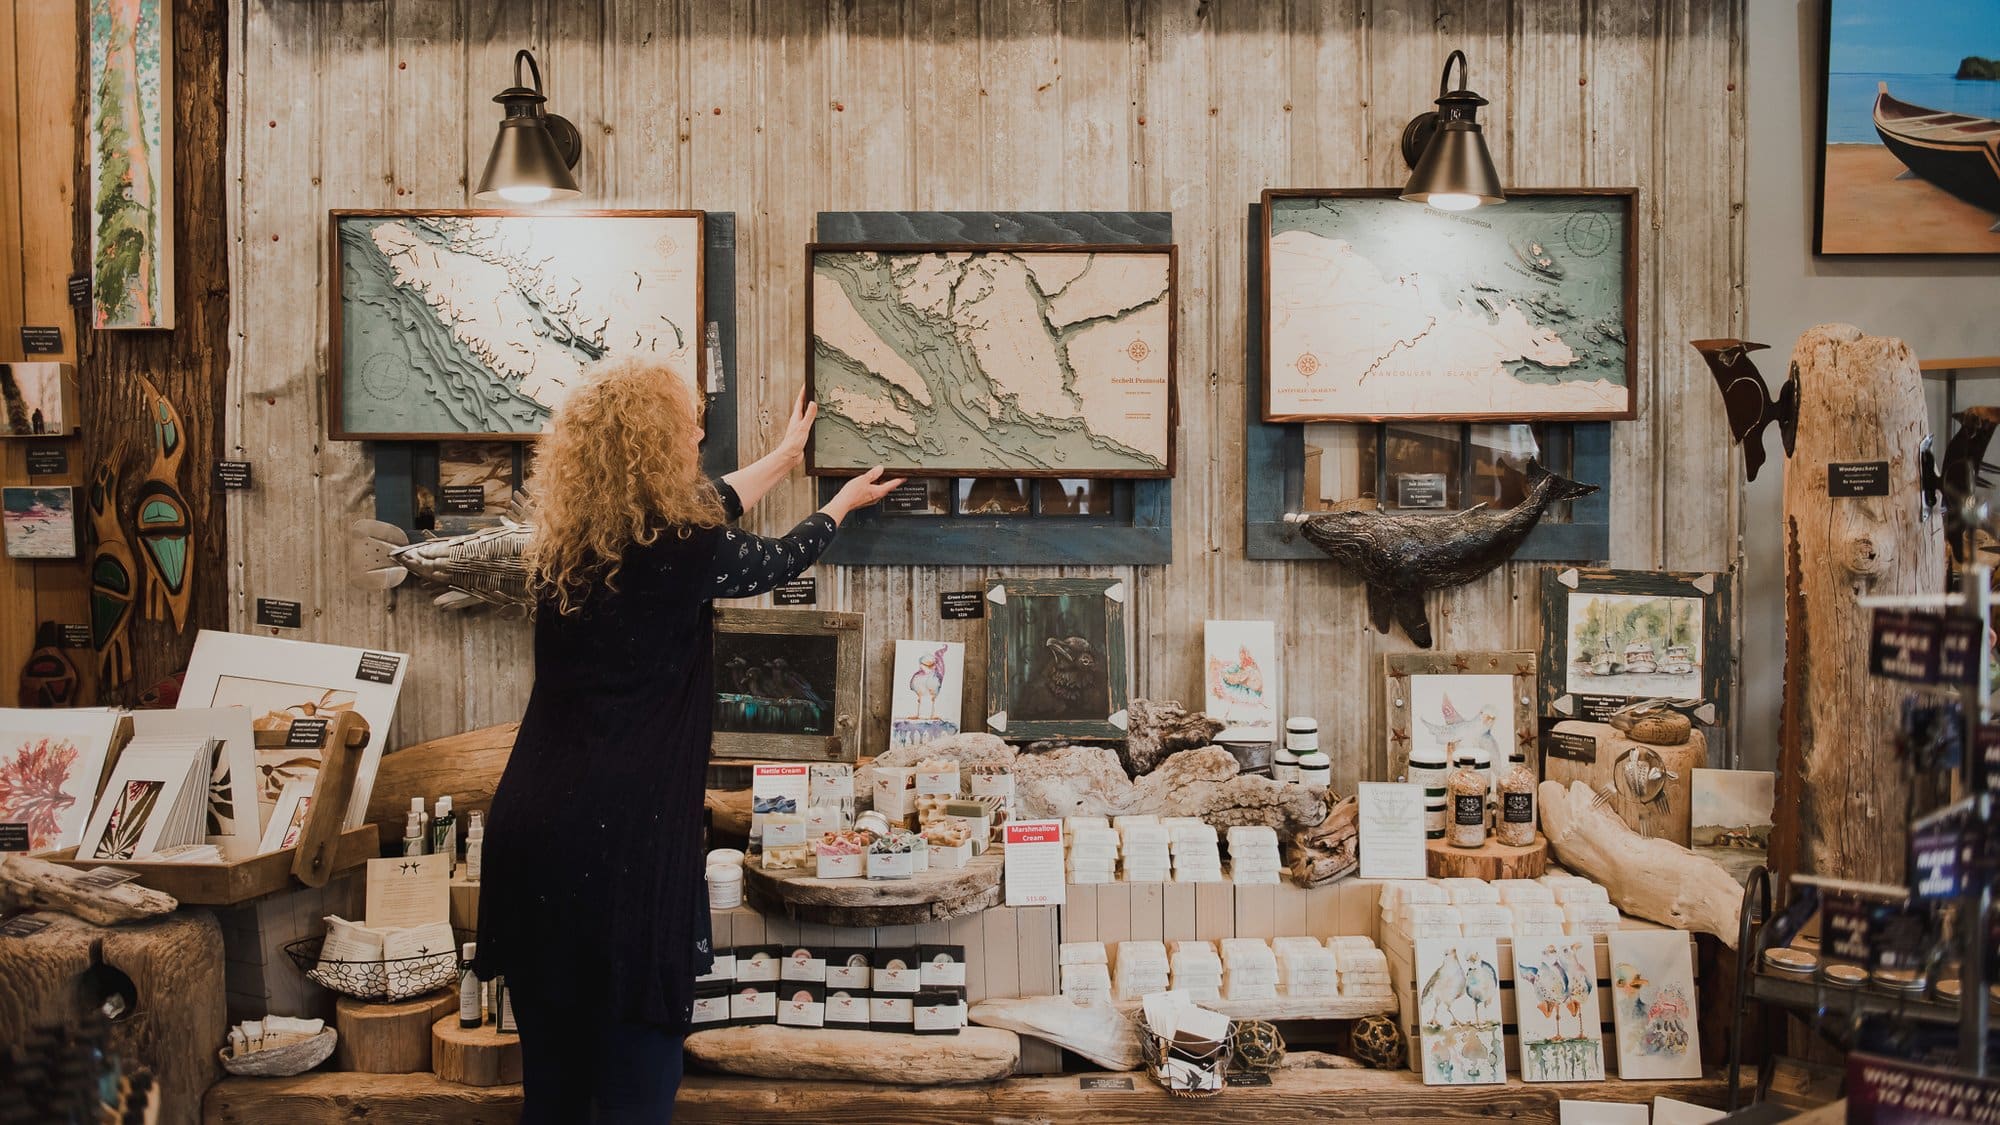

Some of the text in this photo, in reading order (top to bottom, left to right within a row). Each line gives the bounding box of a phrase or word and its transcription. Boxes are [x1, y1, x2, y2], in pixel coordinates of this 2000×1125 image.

[1459, 216, 1493, 230] GEORGIA
[1442, 369, 1479, 377] ISLAND
[1111, 376, 1134, 384] Sechelt
[1011, 825, 1056, 833] Marshmallow
[1022, 834, 1044, 842] Cream
[1863, 1066, 1910, 1089] WHO
[1913, 1077, 1981, 1102] WOULD
[1878, 1088, 1902, 1105] TO
[1903, 1092, 1950, 1116] GIVE
